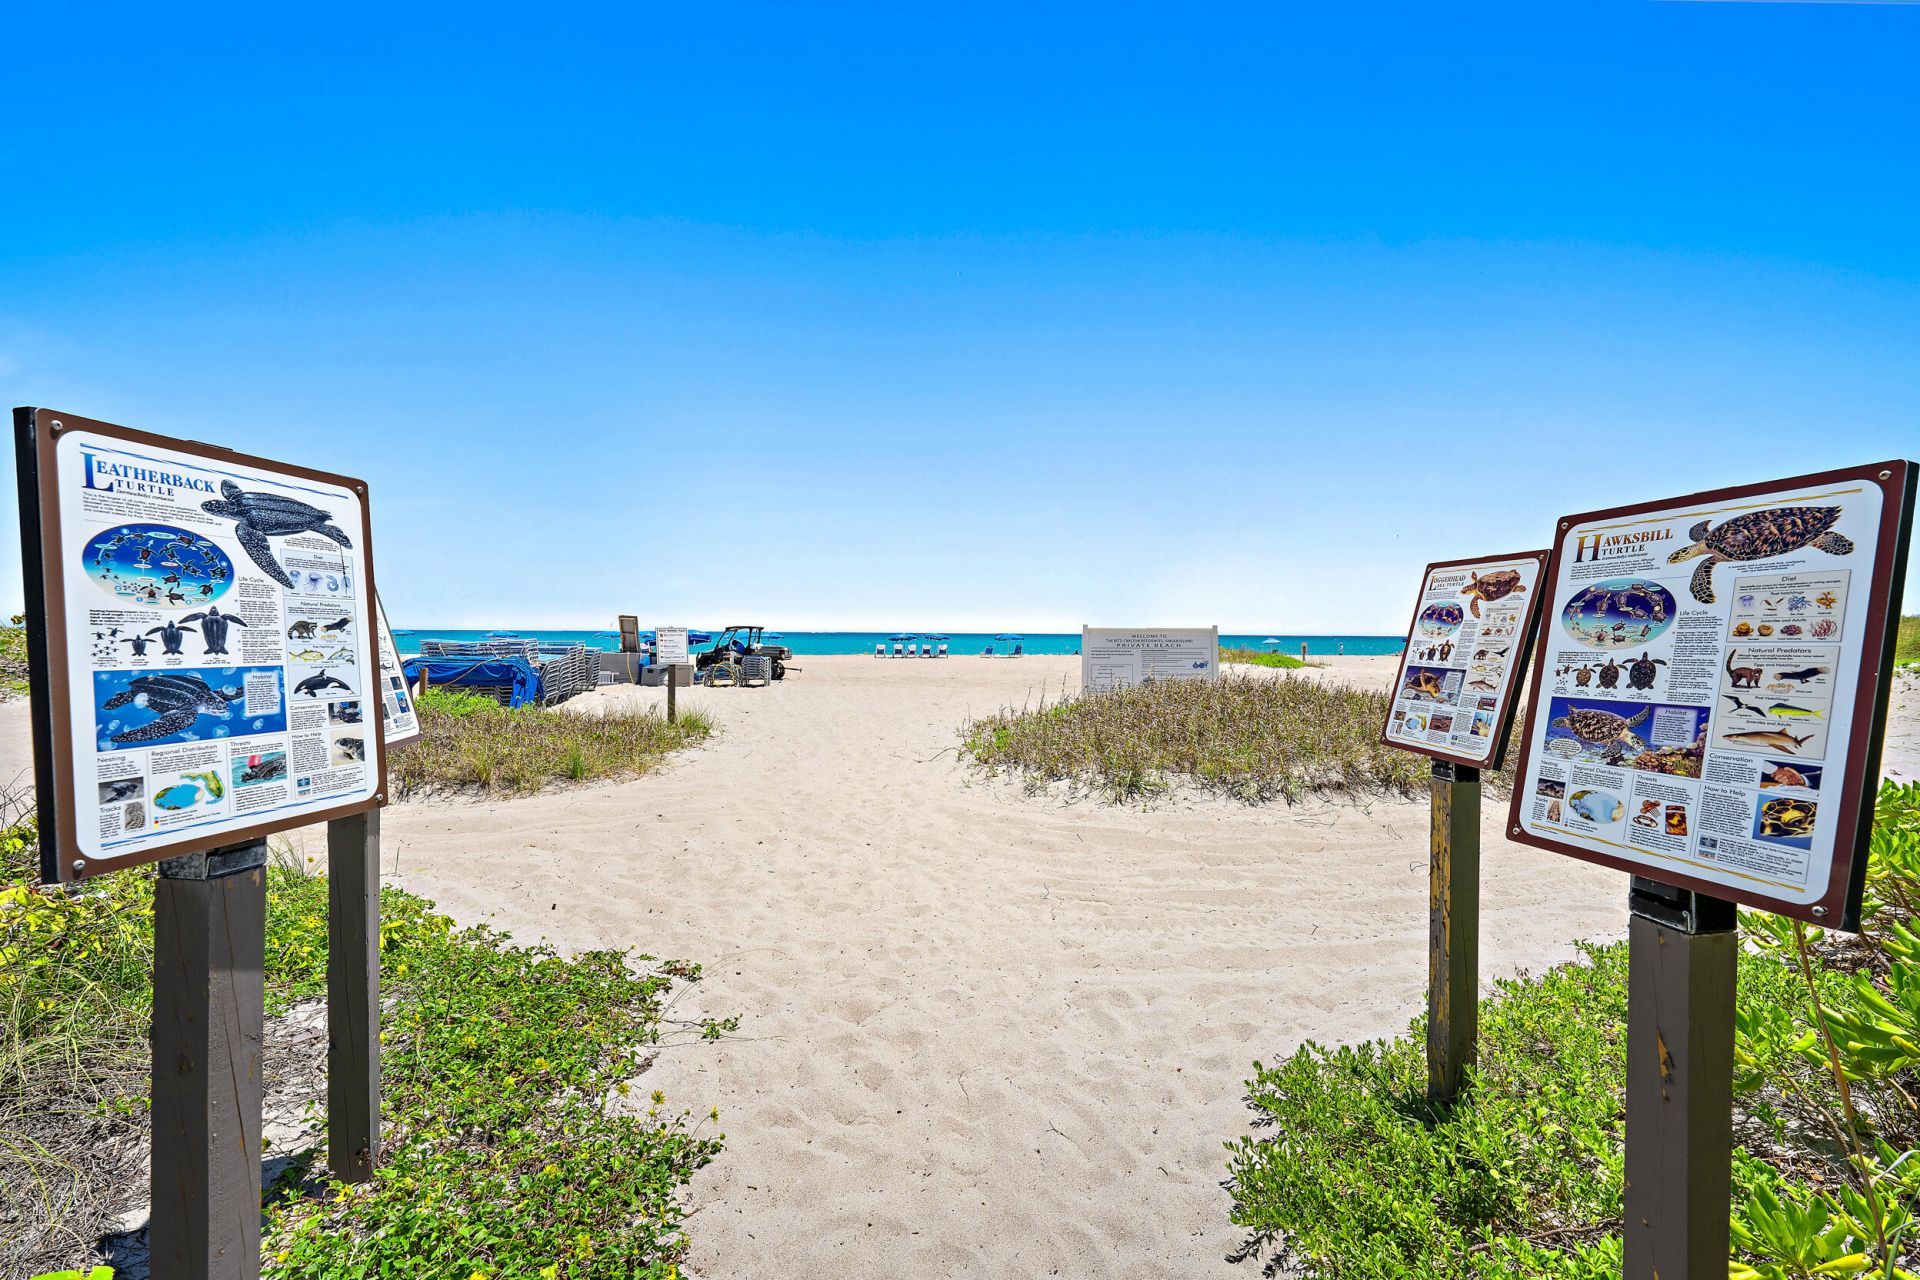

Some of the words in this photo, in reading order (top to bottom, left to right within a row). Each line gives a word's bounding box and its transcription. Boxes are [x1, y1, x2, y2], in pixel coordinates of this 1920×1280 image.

[80, 452, 216, 493] LEATHERBACK
[115, 478, 175, 496] TURTLE
[1573, 528, 1674, 563] HAWKSBILL
[1602, 544, 1646, 556] TURTLE
[1429, 575, 1466, 591] LOGGERHEAD
[151, 748, 181, 757] Regional
[182, 744, 218, 753] Distribution
[1709, 753, 1754, 763] Conservation
[1573, 764, 1595, 773] Regional
[1595, 767, 1625, 777] Distribution
[1637, 774, 1658, 782] Threats
[1704, 785, 1719, 793] How
[1729, 789, 1746, 797] Help
